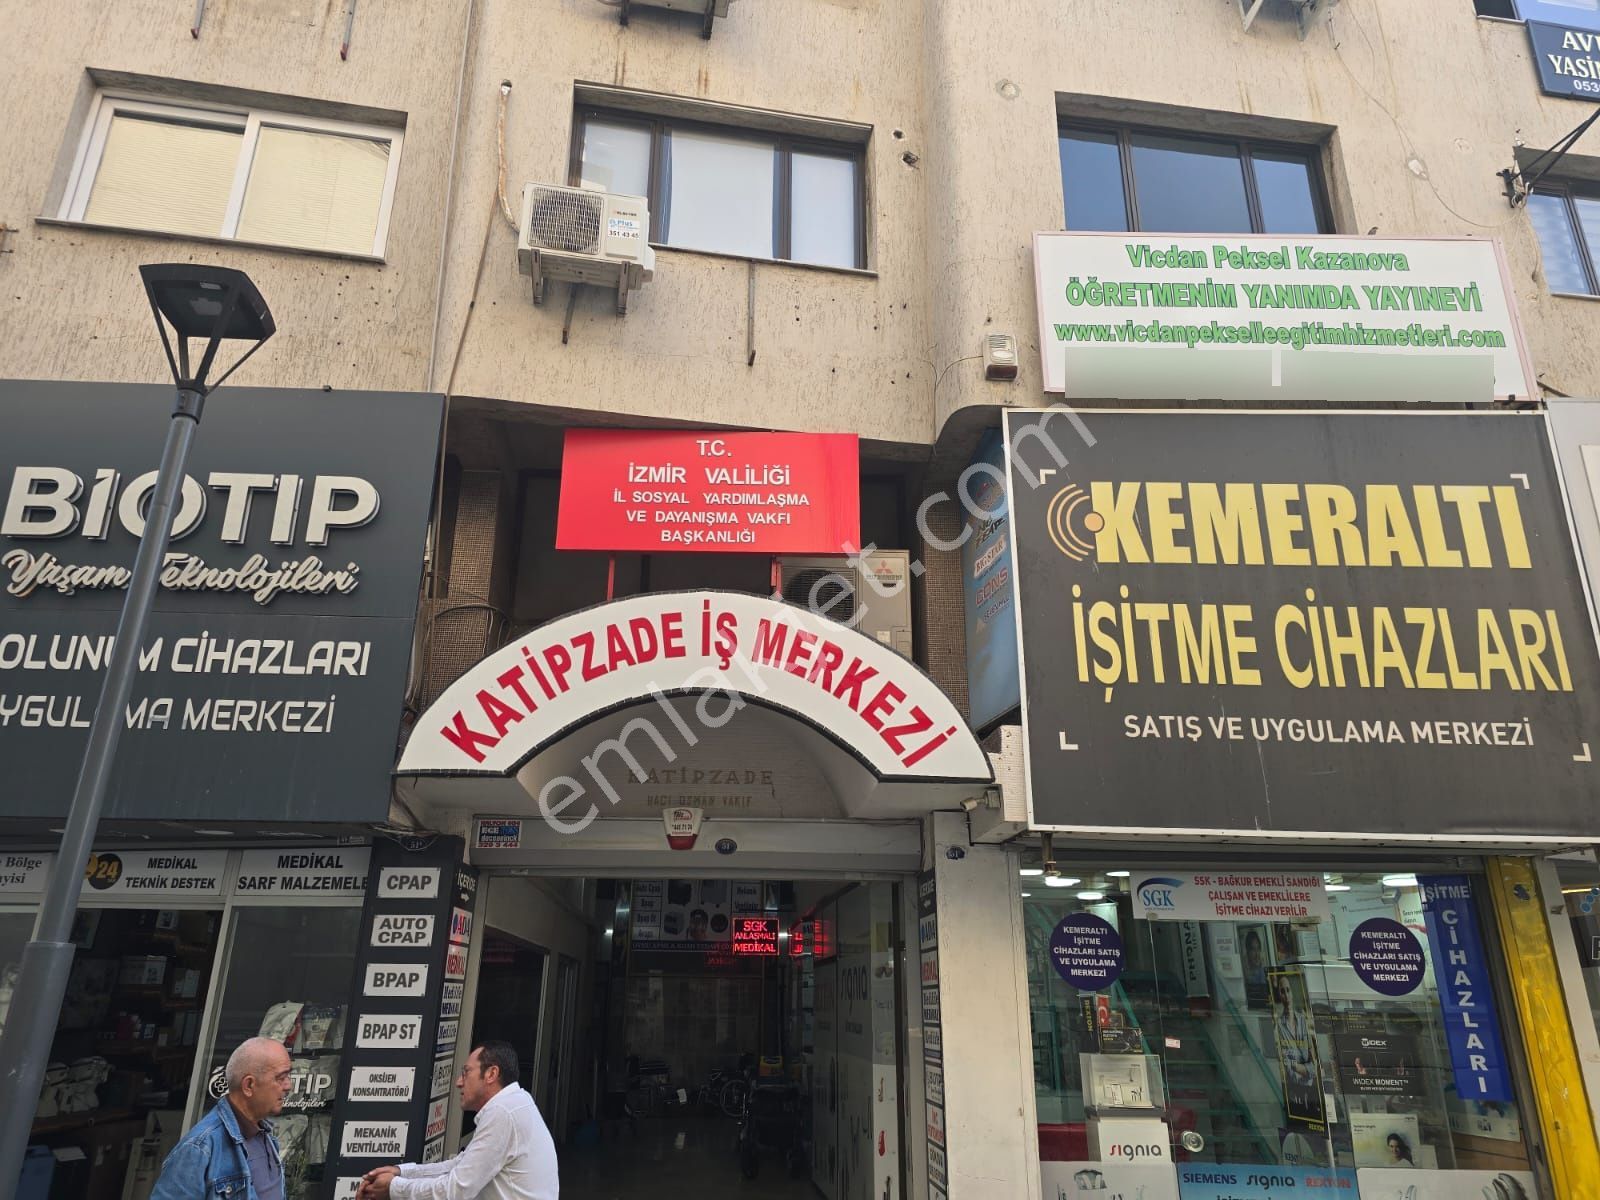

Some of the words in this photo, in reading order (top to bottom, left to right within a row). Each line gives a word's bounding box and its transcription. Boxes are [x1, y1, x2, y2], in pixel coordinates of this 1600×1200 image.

[1573, 79, 1600, 94] 053
[1125, 244, 1208, 270] Vicdan
[1213, 245, 1291, 270] Peksel
[1296, 246, 1410, 272] Kazanova
[1065, 276, 1238, 308] ÖĞRETMENİM
[1241, 283, 1361, 311] YANIMDA
[1362, 281, 1483, 313] YAYINEVİ
[1054, 319, 1506, 350] www.vicdanpekselleegitimhizmetleri.com
[695, 439, 732, 457] T.C.
[628, 462, 687, 484] İZMİR
[705, 463, 791, 486] VALİLİĞİ
[613, 488, 626, 503] İL
[632, 490, 690, 504] SOSYAL
[703, 492, 810, 508] YARDIMLAŞMA
[626, 510, 647, 523] VE
[655, 510, 739, 526] DAYANIŞMA
[747, 511, 791, 525] VAKFI
[1089, 480, 1533, 569] KEMERALTI
[660, 528, 756, 545] BAŞKANLIĞI
[1071, 583, 1262, 703] İŞİTME
[1274, 587, 1574, 692] CİHAZLARI
[170, 631, 372, 677] CİHAZLARI
[439, 611, 686, 764] KATİPZADE
[700, 598, 739, 671] İŞ
[750, 617, 957, 769] MERKEZİ
[0, 695, 174, 730] YGULMA
[181, 694, 336, 734] MERKEZİ
[1123, 714, 1202, 742] SATIŞ
[1208, 716, 1244, 741] VE
[1251, 718, 1406, 745] UYGULAMA
[1411, 716, 1535, 747] MERKEZİ
[5, 856, 42, 871] Bölge
[147, 856, 198, 869] MEDİKAL
[277, 852, 344, 869] MEDİKAL
[125, 875, 167, 889] TEKNİK
[171, 876, 216, 889] DESTEK
[238, 876, 277, 890] SARF
[386, 874, 432, 890] CPAP
[1194, 876, 1211, 886] SSK
[1218, 875, 1252, 886] BAĞKUR
[1254, 875, 1285, 887] EMEKLİ
[1286, 876, 1321, 888] SANDIĞI
[1143, 889, 1175, 907] SGK
[1208, 890, 1244, 902] ÇALIŞAN
[1246, 891, 1257, 901] VE
[1258, 889, 1312, 902] EMEKLİLERE
[1420, 883, 1470, 903] İŞİTME
[1215, 903, 1245, 917] İŞİTME
[1246, 904, 1273, 916] CİHAZI
[1275, 904, 1308, 916] VERİLİR
[379, 917, 428, 930] AUTO
[743, 920, 768, 932] SGK
[1063, 926, 1108, 935] KEMERALTI
[377, 931, 426, 943] CPAP
[1074, 936, 1101, 946] İŞİTME
[1360, 931, 1407, 939] KEMERALTI
[734, 941, 776, 953] MEDİKAL
[1053, 945, 1096, 955] CİHAZLARI
[1097, 948, 1121, 958] SATIŞ
[1373, 941, 1401, 951] İŞİTME
[1059, 957, 1071, 965] VE
[1072, 958, 1117, 967] UYGULAMA
[1353, 950, 1396, 960] CİHAZLARI
[1398, 953, 1421, 962] SATIŞ
[1070, 968, 1107, 977] MERKEZİ
[1360, 962, 1372, 971] VE
[1373, 963, 1419, 972] UYGULAMA
[372, 972, 420, 988] BPAP
[1373, 972, 1410, 982] MERKEZİ
[1441, 909, 1489, 1093] CİHAZLARI
[362, 1023, 398, 1039] BPAP
[400, 1023, 416, 1040] ST
[352, 1086, 410, 1097] KONSANTRATÖRÜ
[353, 1126, 398, 1138] MEKANİK
[346, 1141, 401, 1154] VENTİLATÖR
[1109, 1144, 1162, 1161] signia
[1183, 1172, 1238, 1185] SIEMENS
[1246, 1175, 1296, 1190] signia
